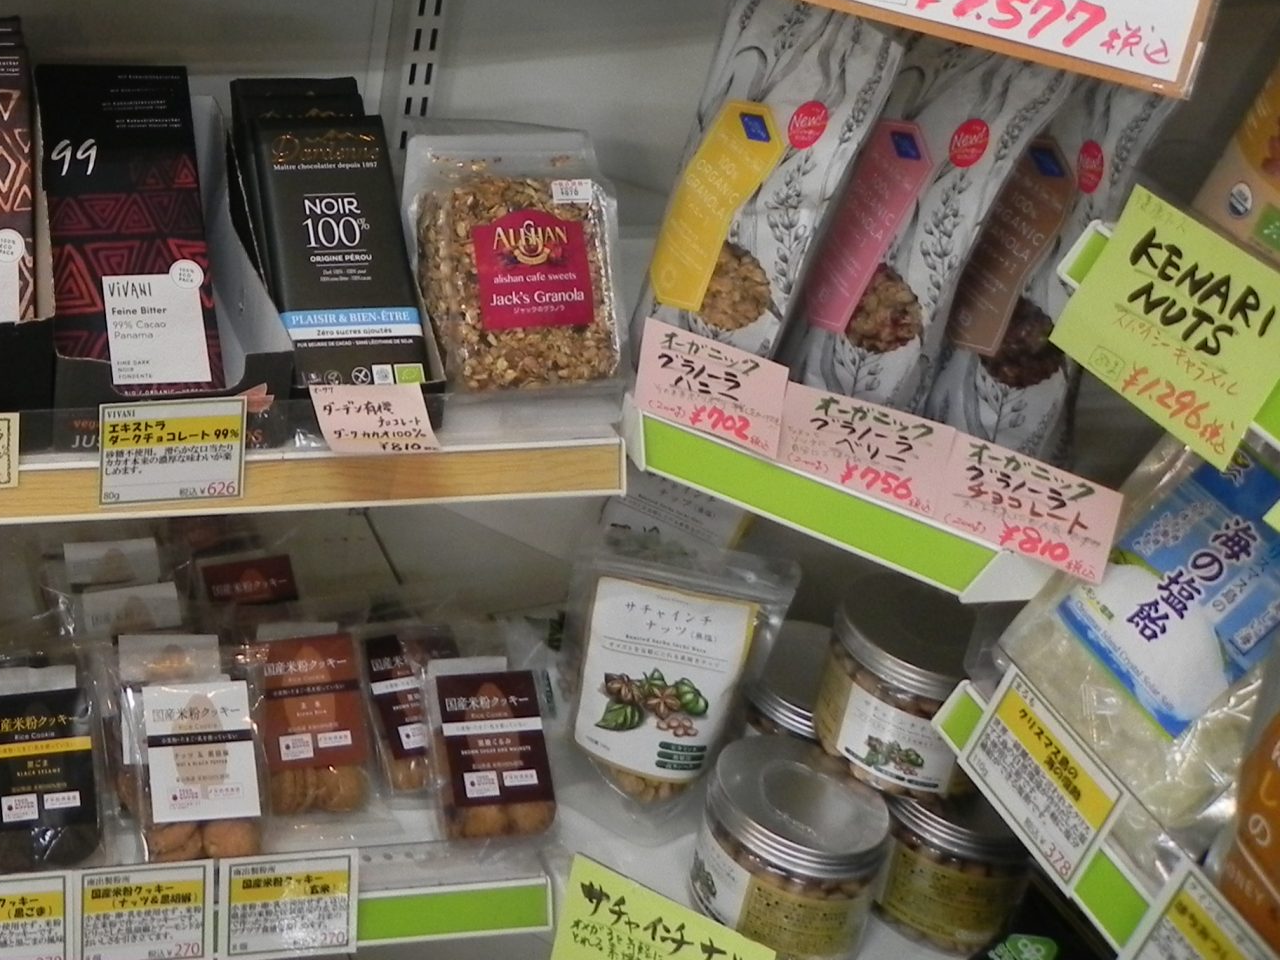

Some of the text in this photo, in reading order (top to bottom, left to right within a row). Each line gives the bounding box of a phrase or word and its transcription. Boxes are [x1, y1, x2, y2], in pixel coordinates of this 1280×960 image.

[51, 138, 98, 176] 99
[303, 198, 361, 215] NOIR
[310, 252, 372, 263] ORIGINE PÉROU
[493, 272, 577, 284] alishan cafe sweets
[1129, 226, 1276, 338] KENARI
[490, 289, 585, 307] Jack's Granola
[112, 306, 167, 317] Feine Bitter
[292, 313, 336, 325] PLAISIR
[338, 312, 347, 322] &
[1127, 280, 1238, 357] NUTS
[112, 319, 167, 329] 99% Cacao
[114, 331, 154, 340] Panama
[107, 410, 136, 418] VIVANI
[108, 420, 166, 434] エキストラ
[108, 428, 239, 445] ダークチョコレート 99%
[1126, 516, 1259, 644] 海の塩飴
[264, 656, 348, 676] 国産米粉クッキー
[445, 693, 529, 713] 国産米粉クッキー
[151, 705, 241, 723] 国産米粉クッキー
